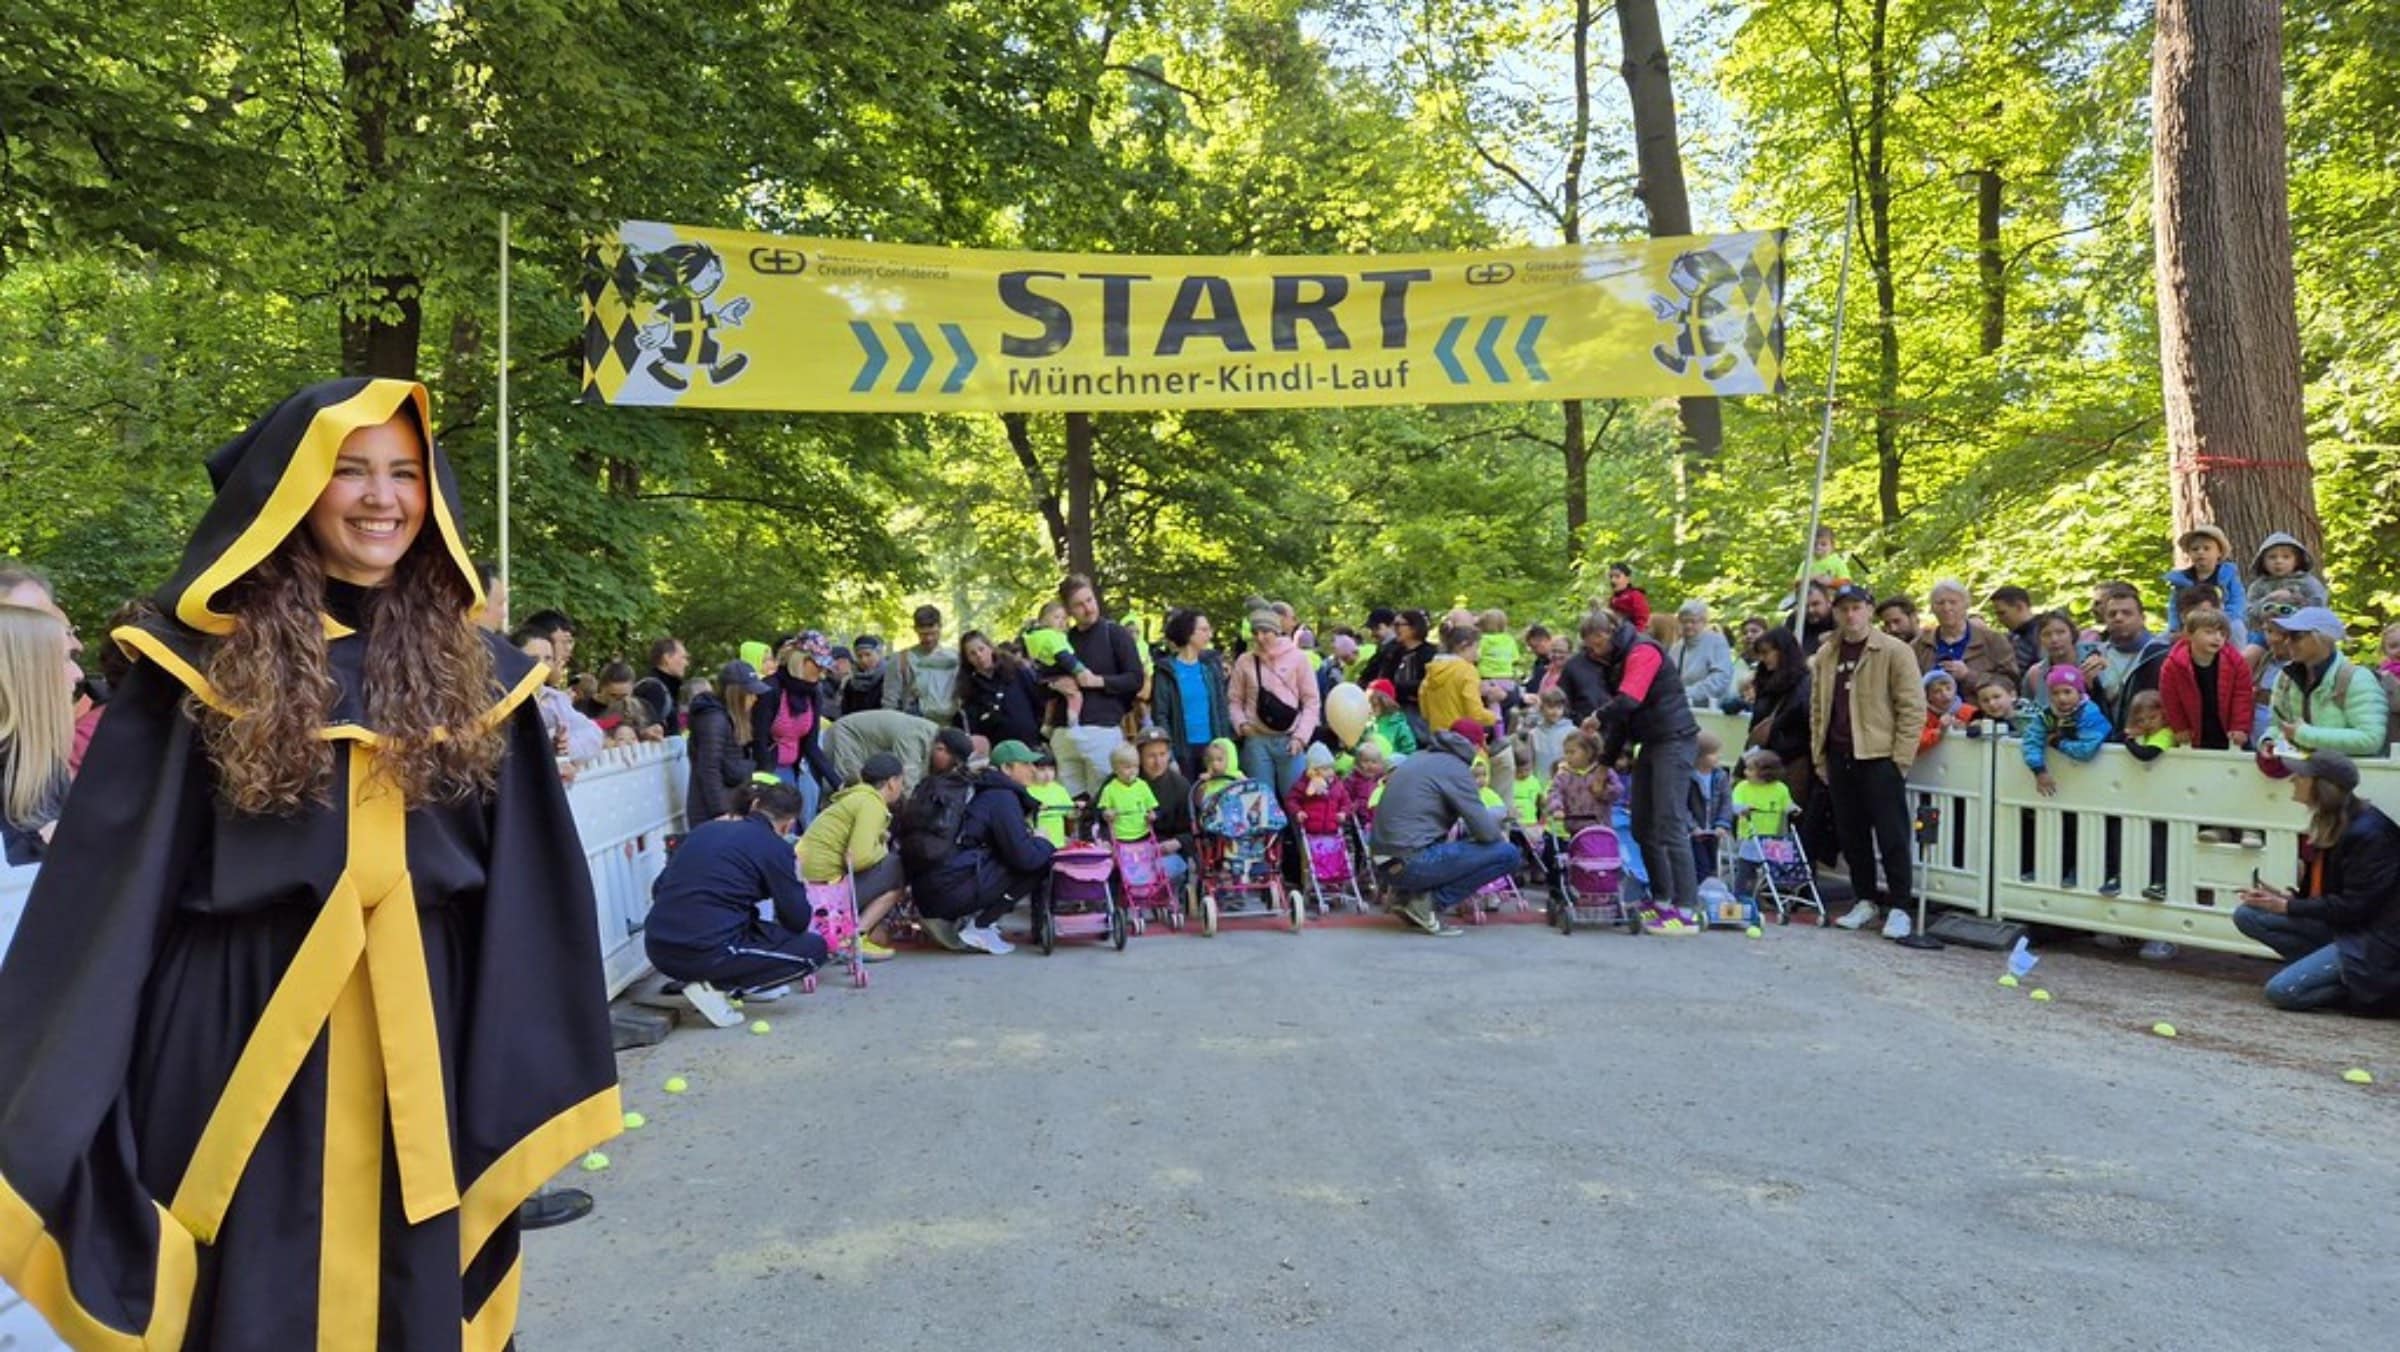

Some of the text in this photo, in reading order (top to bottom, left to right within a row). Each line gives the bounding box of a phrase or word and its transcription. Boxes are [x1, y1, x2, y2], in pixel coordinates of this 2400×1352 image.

[817, 263, 950, 281] Creating Confidence
[998, 269, 1432, 358] START
[1009, 360, 1409, 396] Münchner-Kindl-Lauf
